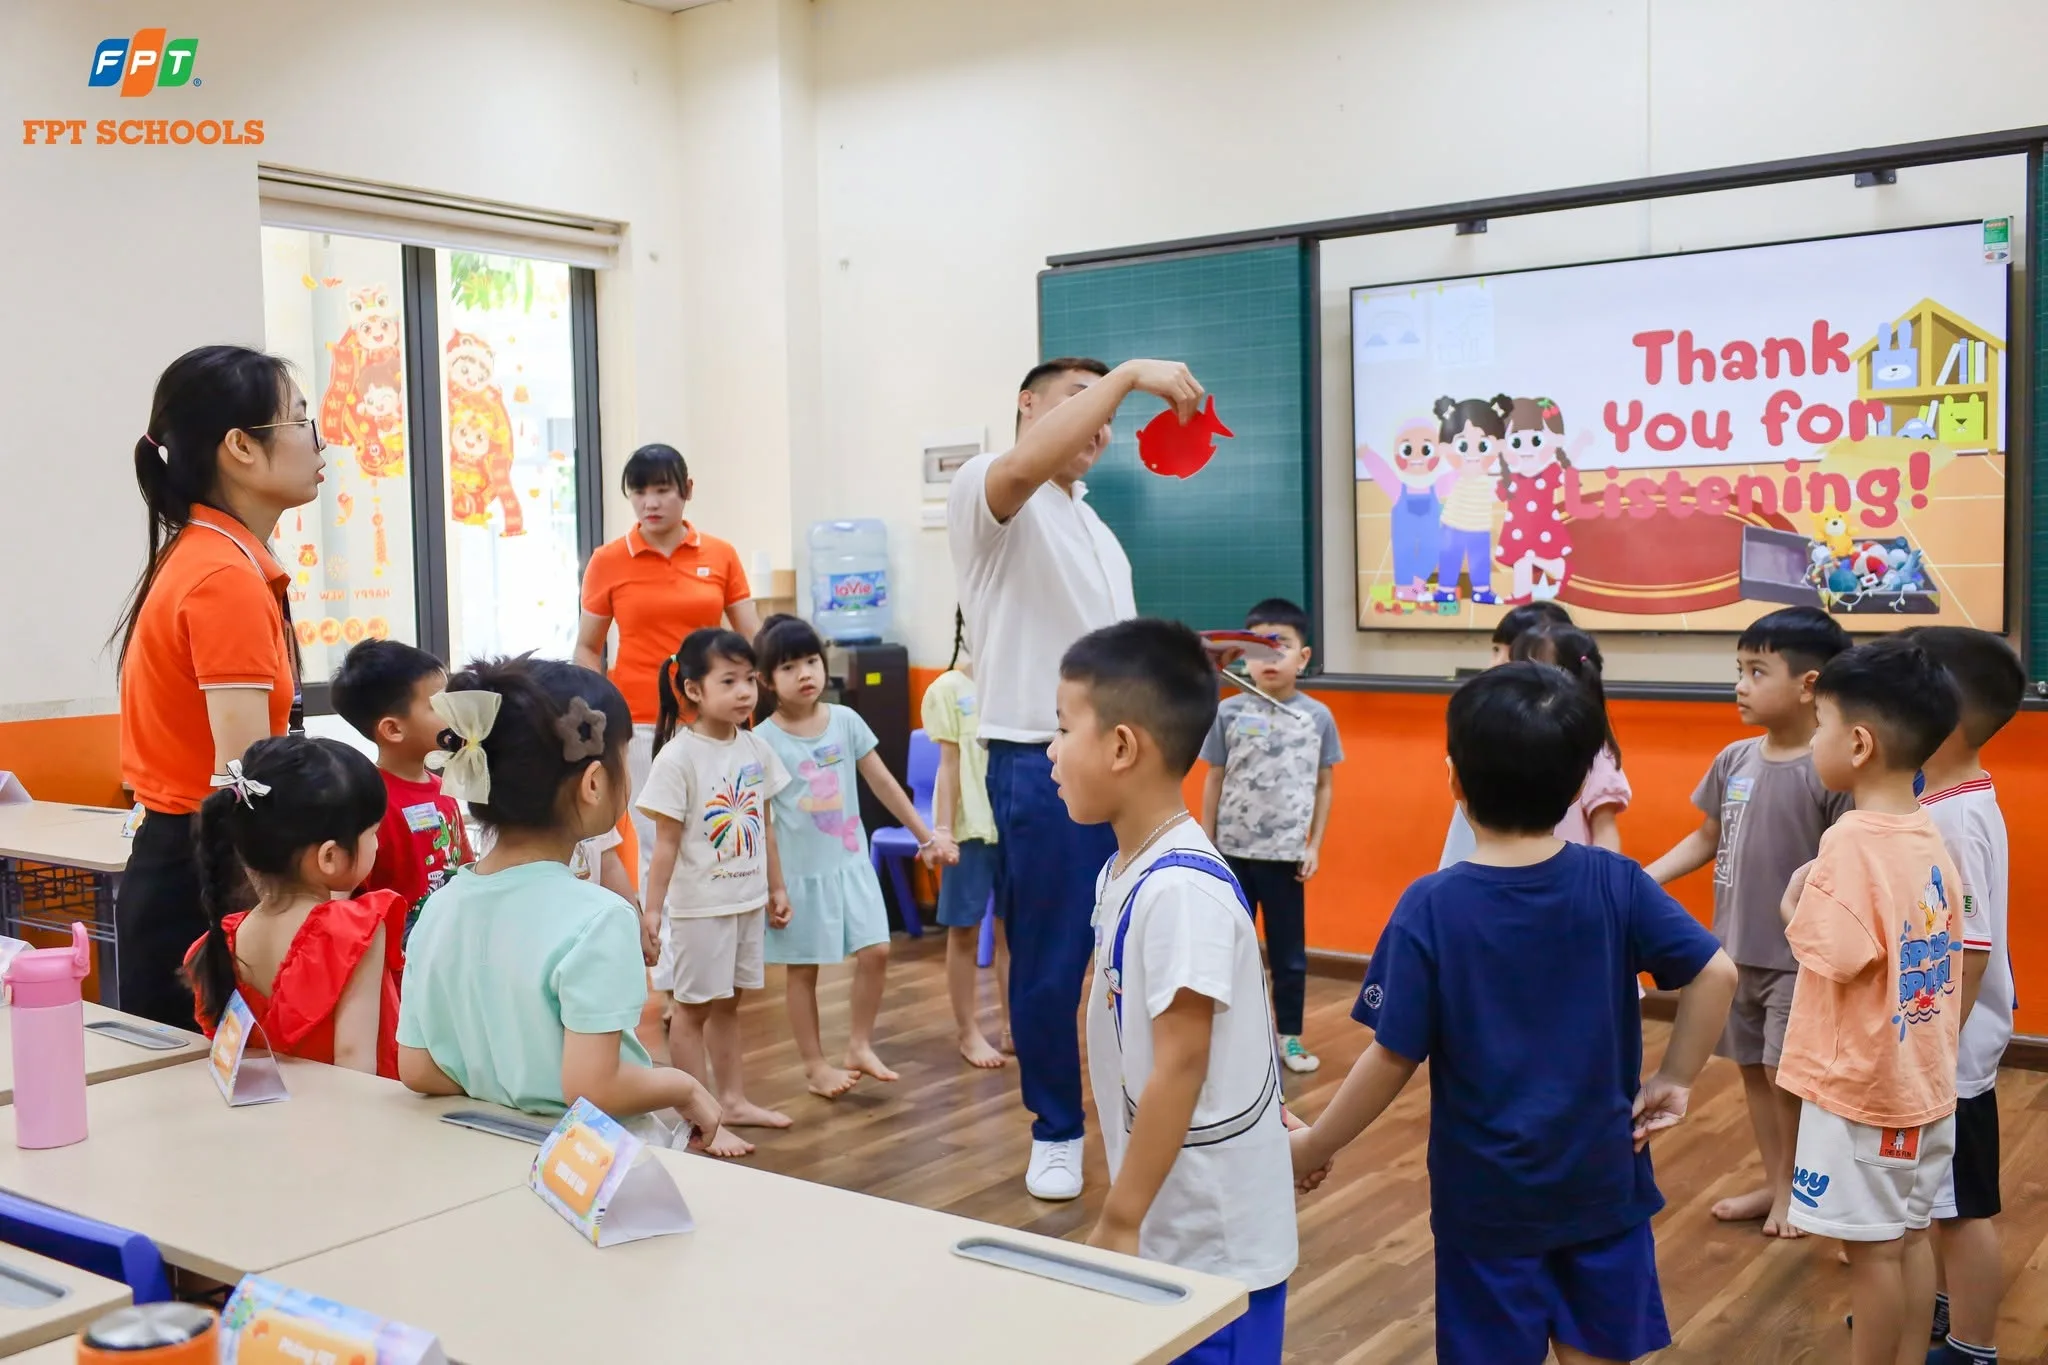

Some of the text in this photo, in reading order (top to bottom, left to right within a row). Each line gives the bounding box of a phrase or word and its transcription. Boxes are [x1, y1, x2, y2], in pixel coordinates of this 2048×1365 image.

[1632, 319, 1850, 385] Thank
[1603, 389, 1886, 453] You for
[1564, 451, 1931, 529] Listening!
[1901, 1150, 1912, 1158] FUN
